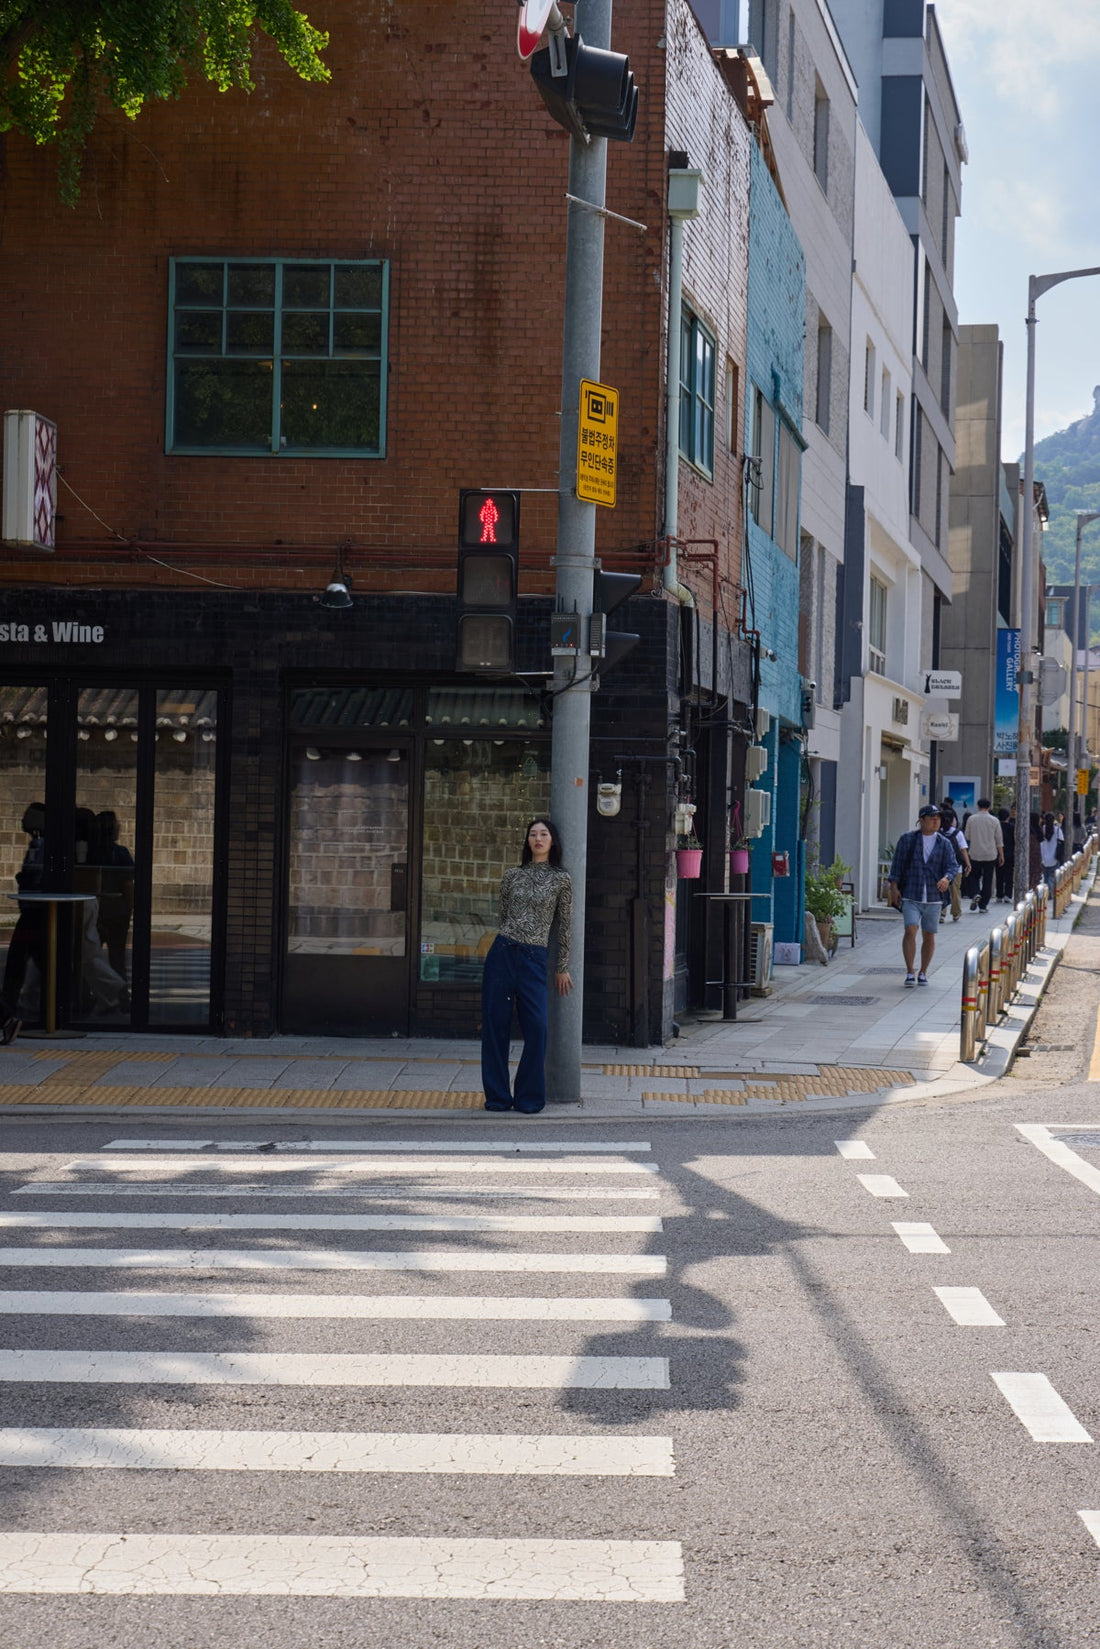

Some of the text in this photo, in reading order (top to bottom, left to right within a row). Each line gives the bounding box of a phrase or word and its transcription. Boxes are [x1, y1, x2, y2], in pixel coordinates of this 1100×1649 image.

[581, 428, 615, 452] 불법주정차
[581, 451, 614, 474] 무인단속중
[33, 624, 48, 642] &
[52, 621, 104, 643] Wine
[1006, 657, 1014, 692] GALLERY
